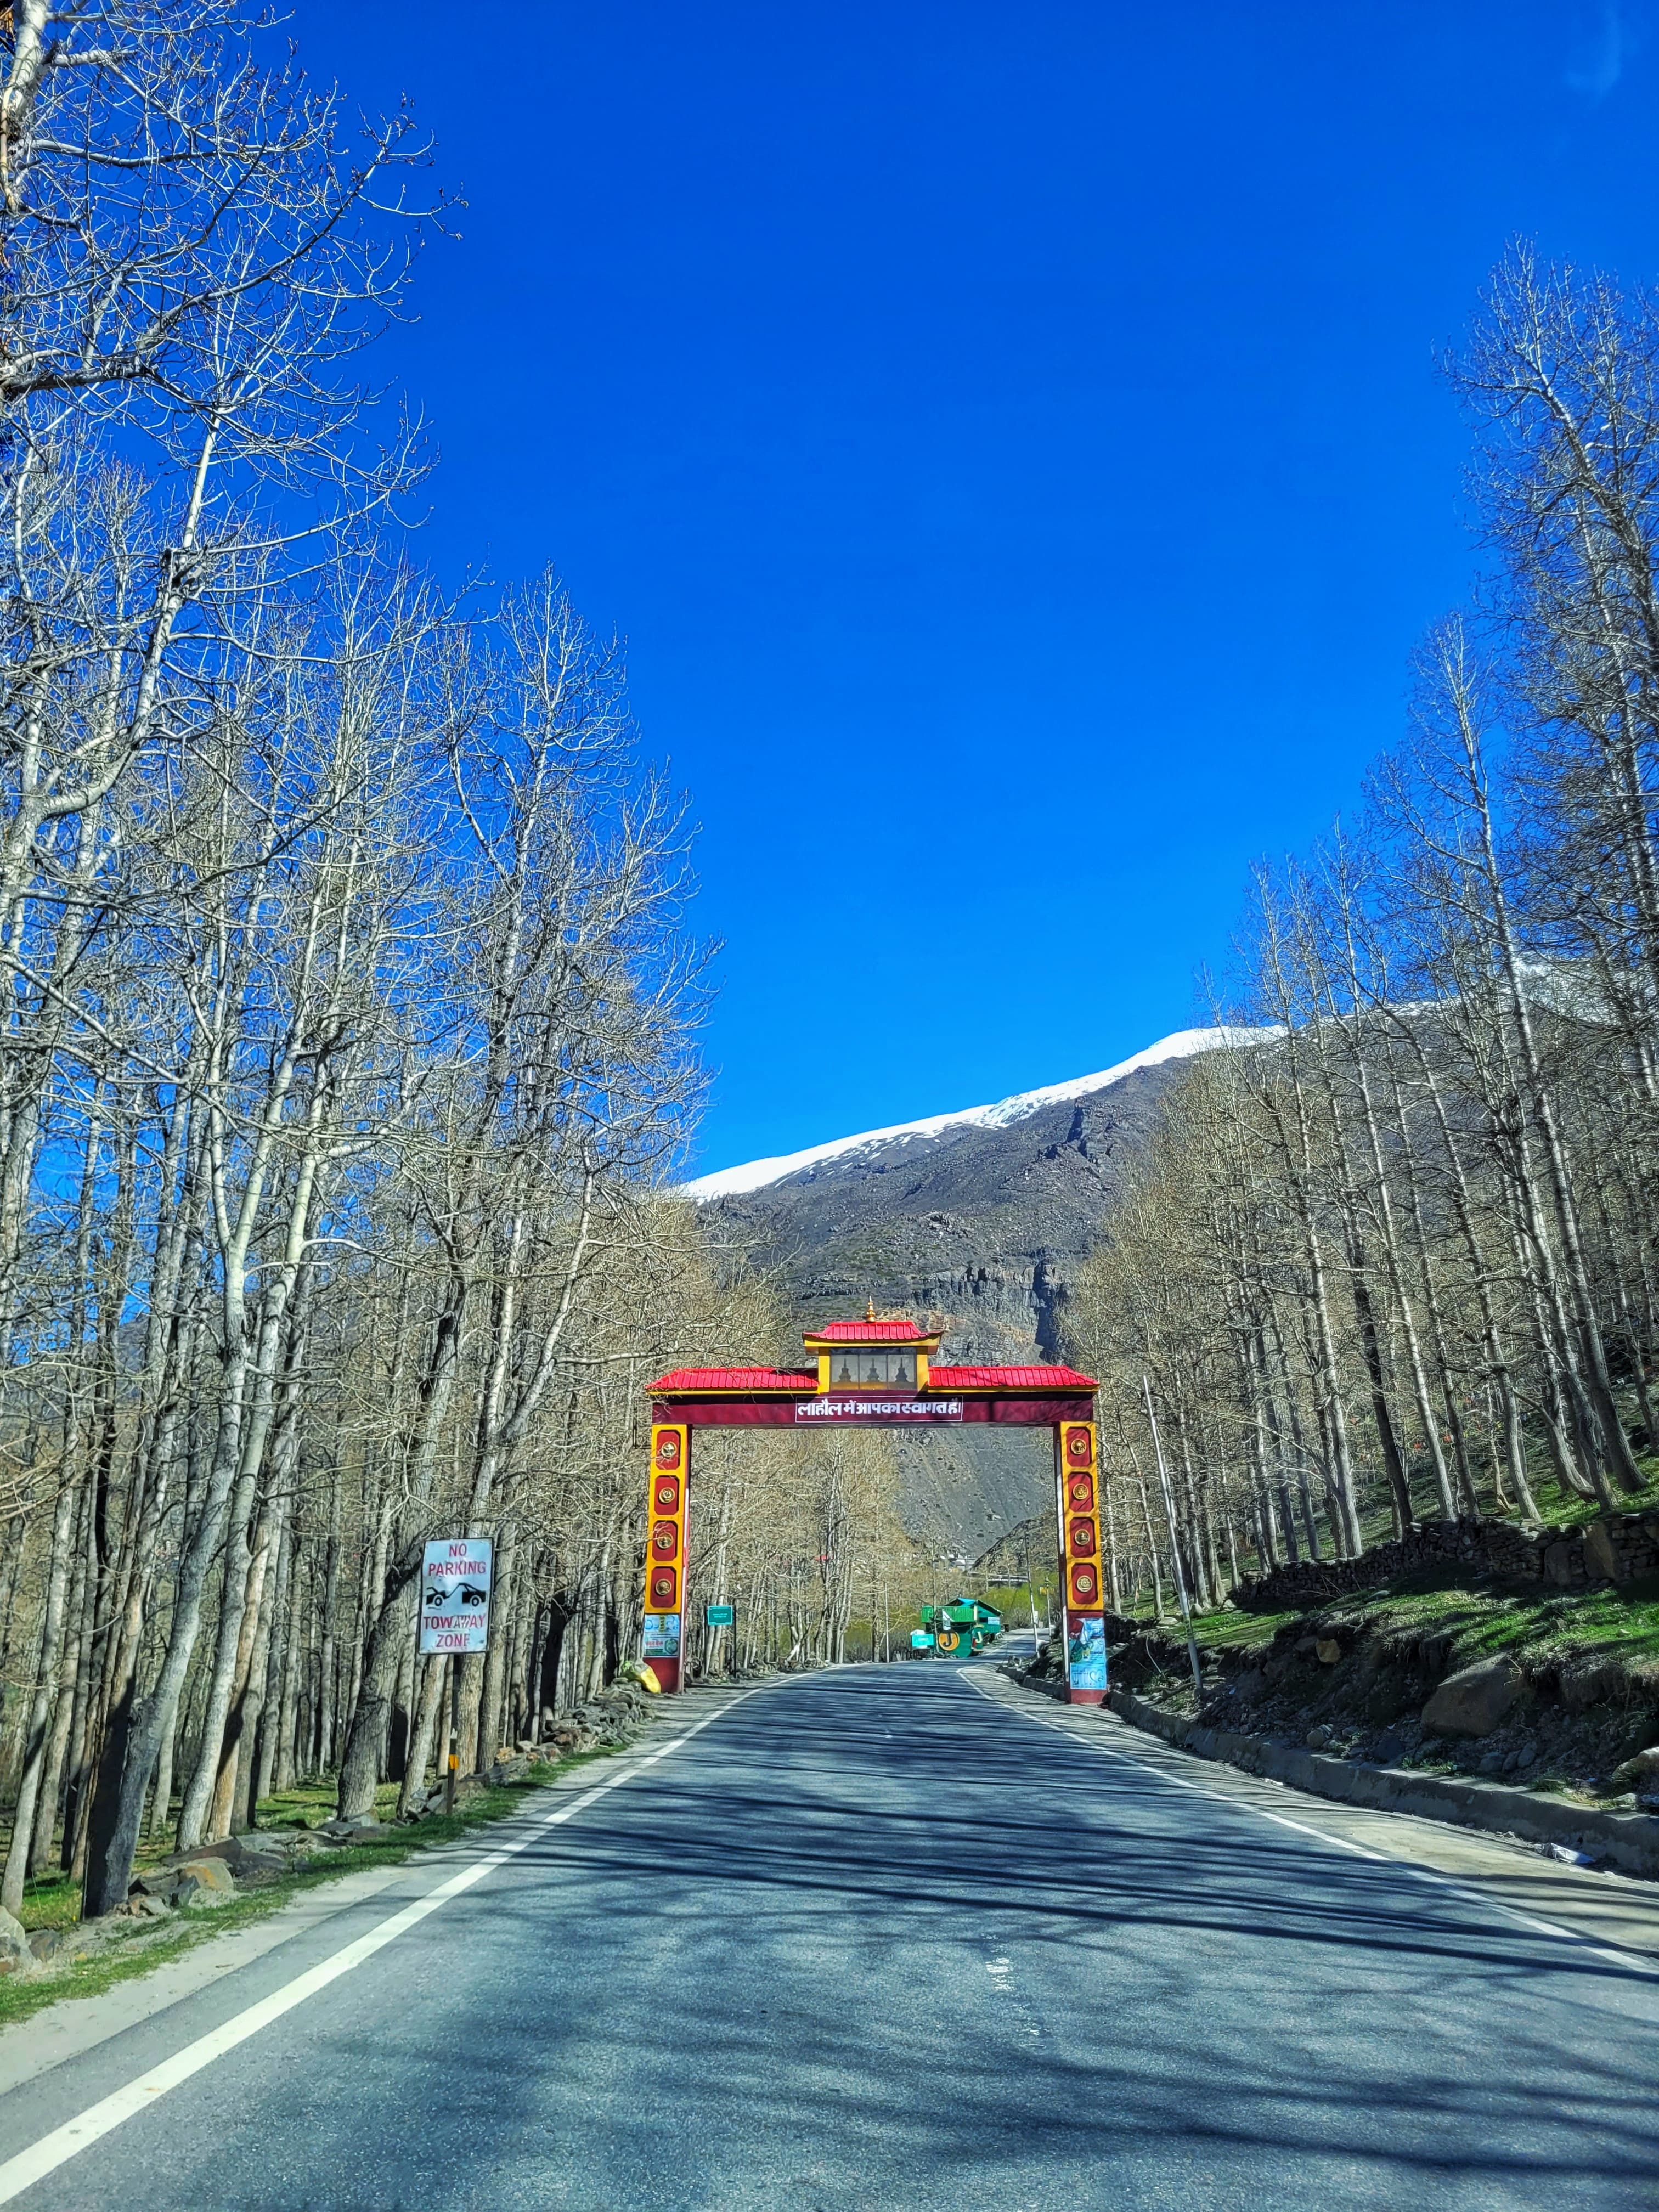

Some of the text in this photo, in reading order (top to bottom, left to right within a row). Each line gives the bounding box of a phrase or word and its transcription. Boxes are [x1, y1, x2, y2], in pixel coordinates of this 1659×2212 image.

[797, 1398, 843, 1416] लाहौल
[901, 1402, 947, 1414] स्वागत
[449, 1543, 467, 1558] NO
[428, 1561, 487, 1576] PARKING
